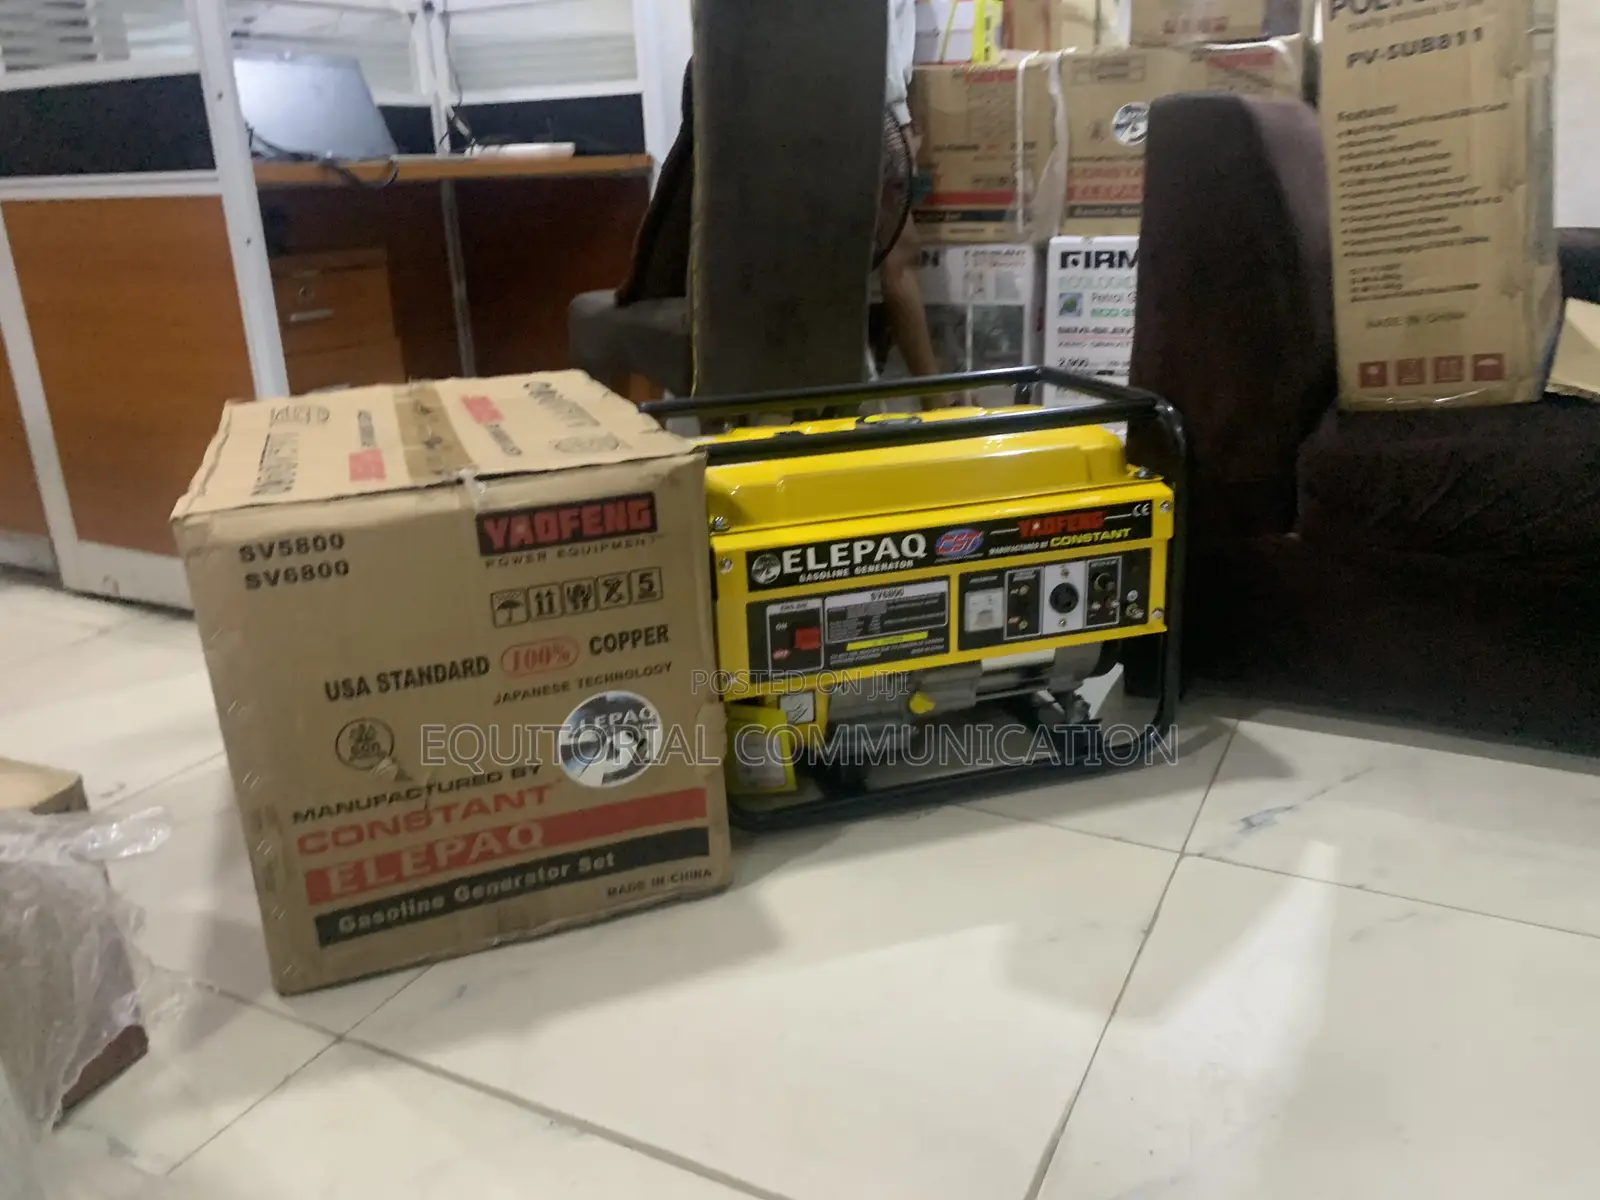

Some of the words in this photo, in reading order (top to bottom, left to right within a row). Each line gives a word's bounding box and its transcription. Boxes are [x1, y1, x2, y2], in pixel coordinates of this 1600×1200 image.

[484, 497, 652, 550] YAOFENG
[1050, 527, 1132, 548] CONSTANT
[239, 532, 346, 563] SV5800
[485, 551, 549, 569] POWER
[557, 536, 657, 560] EQUIPMENT
[781, 533, 928, 575] ELEPAQ
[245, 559, 350, 590] SV6800
[799, 567, 850, 583] GASOLINE
[854, 560, 914, 575] GENERATOR
[324, 675, 372, 702] USA
[375, 654, 490, 696] STANDARD
[506, 643, 573, 674] 100%
[588, 624, 670, 657] COPPER
[493, 680, 573, 706] JAPANESE
[576, 660, 673, 690] TECHNOLOGY
[292, 770, 504, 824] MANUFACTURED
[510, 763, 543, 782] BY
[297, 783, 553, 857] CONSTANT
[325, 820, 545, 896] ELEPAQ
[337, 892, 445, 934] Gasoline
[453, 862, 570, 902] Generator
[577, 851, 616, 878] Set
[606, 878, 646, 898] MADE
[650, 876, 666, 889] IN
[669, 867, 713, 886] CHINA
